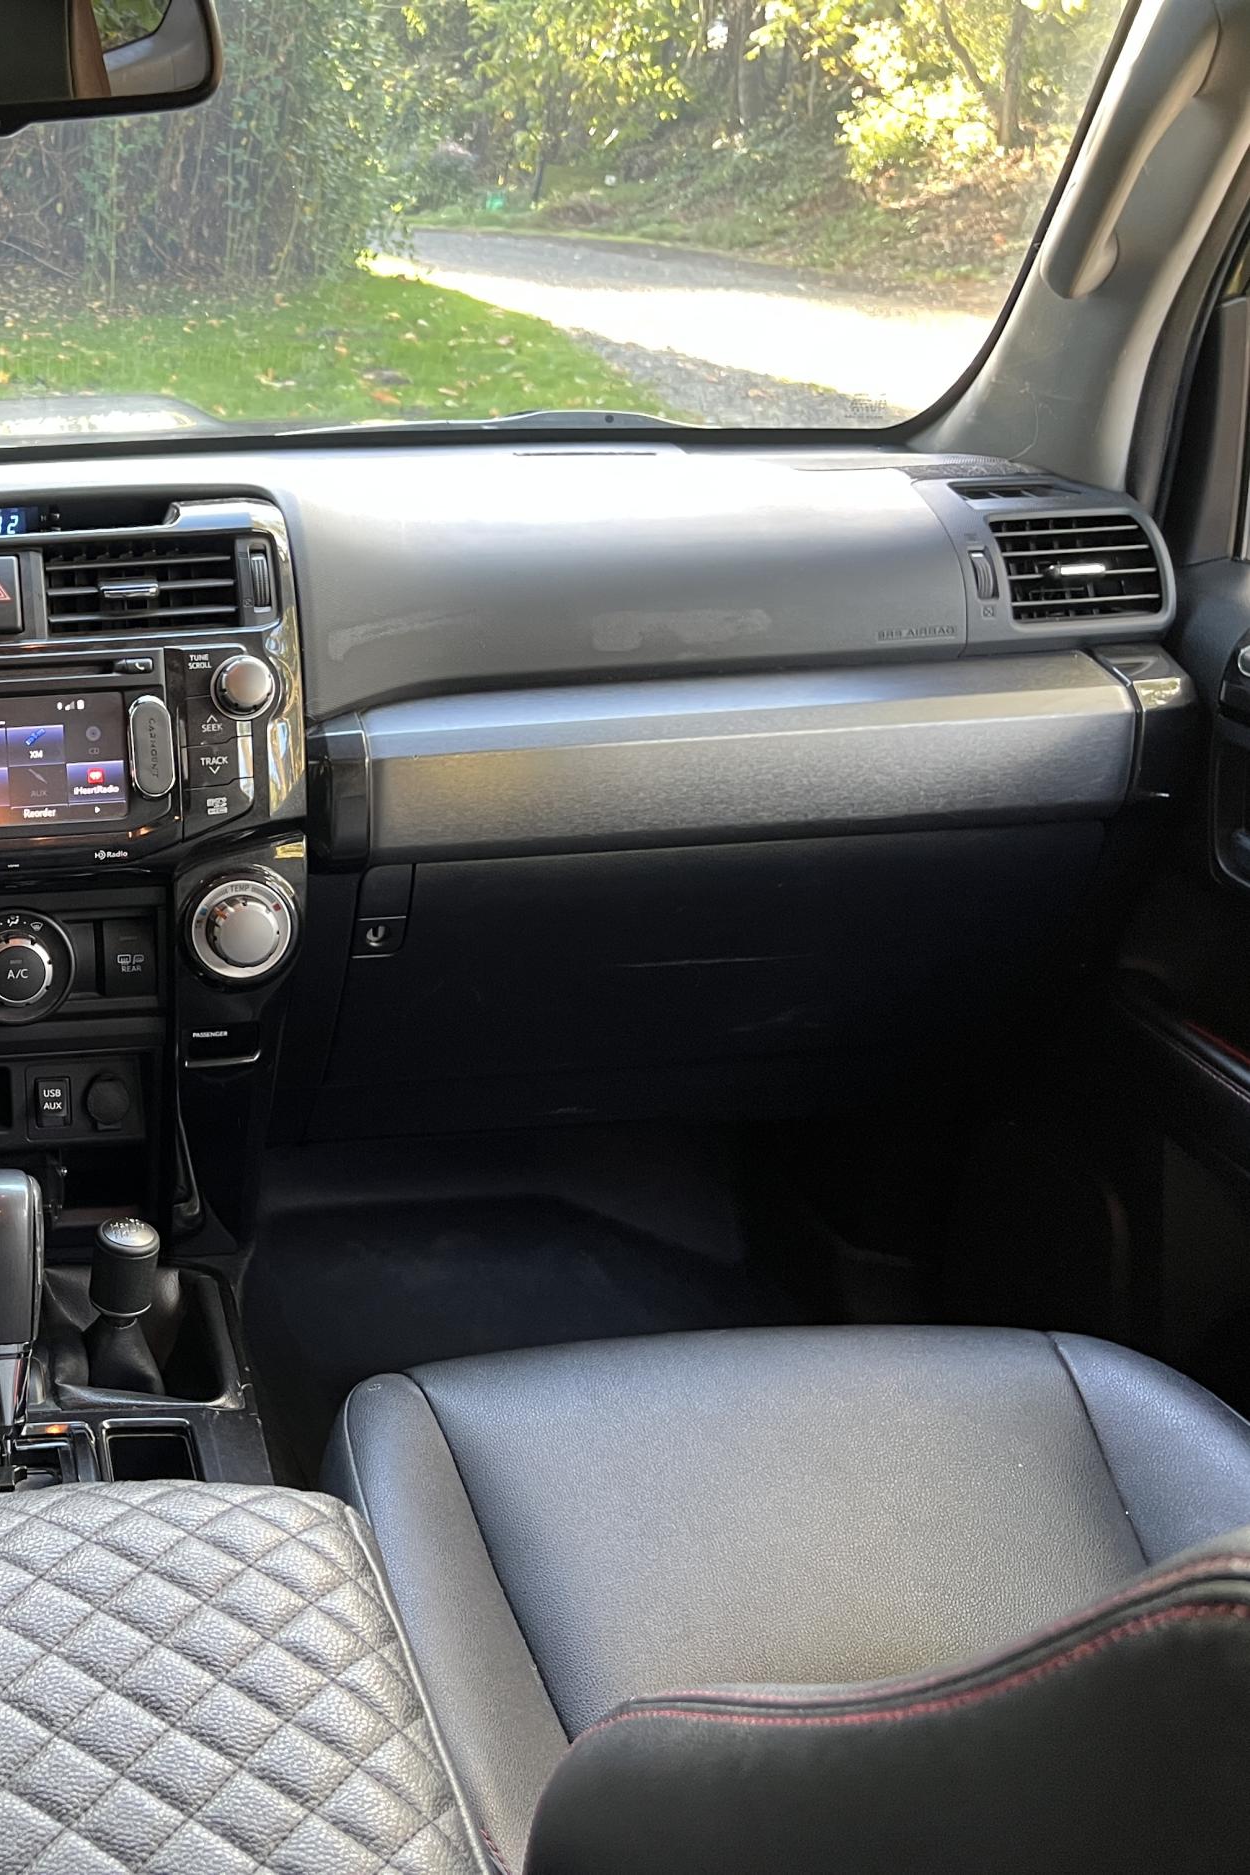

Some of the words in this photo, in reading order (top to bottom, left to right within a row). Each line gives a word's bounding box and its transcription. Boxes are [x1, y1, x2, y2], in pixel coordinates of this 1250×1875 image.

[189, 653, 209, 662] TUNE
[187, 660, 212, 670] SCROLL
[201, 722, 223, 733] SEEK
[29, 750, 43, 759] XM
[200, 756, 229, 766] TRACK
[73, 785, 120, 796] iHeartRadio
[23, 808, 57, 819] Reorder
[106, 850, 129, 858] Radio
[229, 883, 250, 893] TEMP
[6, 968, 29, 980] A/C
[121, 965, 142, 973] REAR
[192, 1030, 228, 1038] PASSENGER
[43, 1089, 62, 1099] USB
[43, 1101, 63, 1111] AUX
